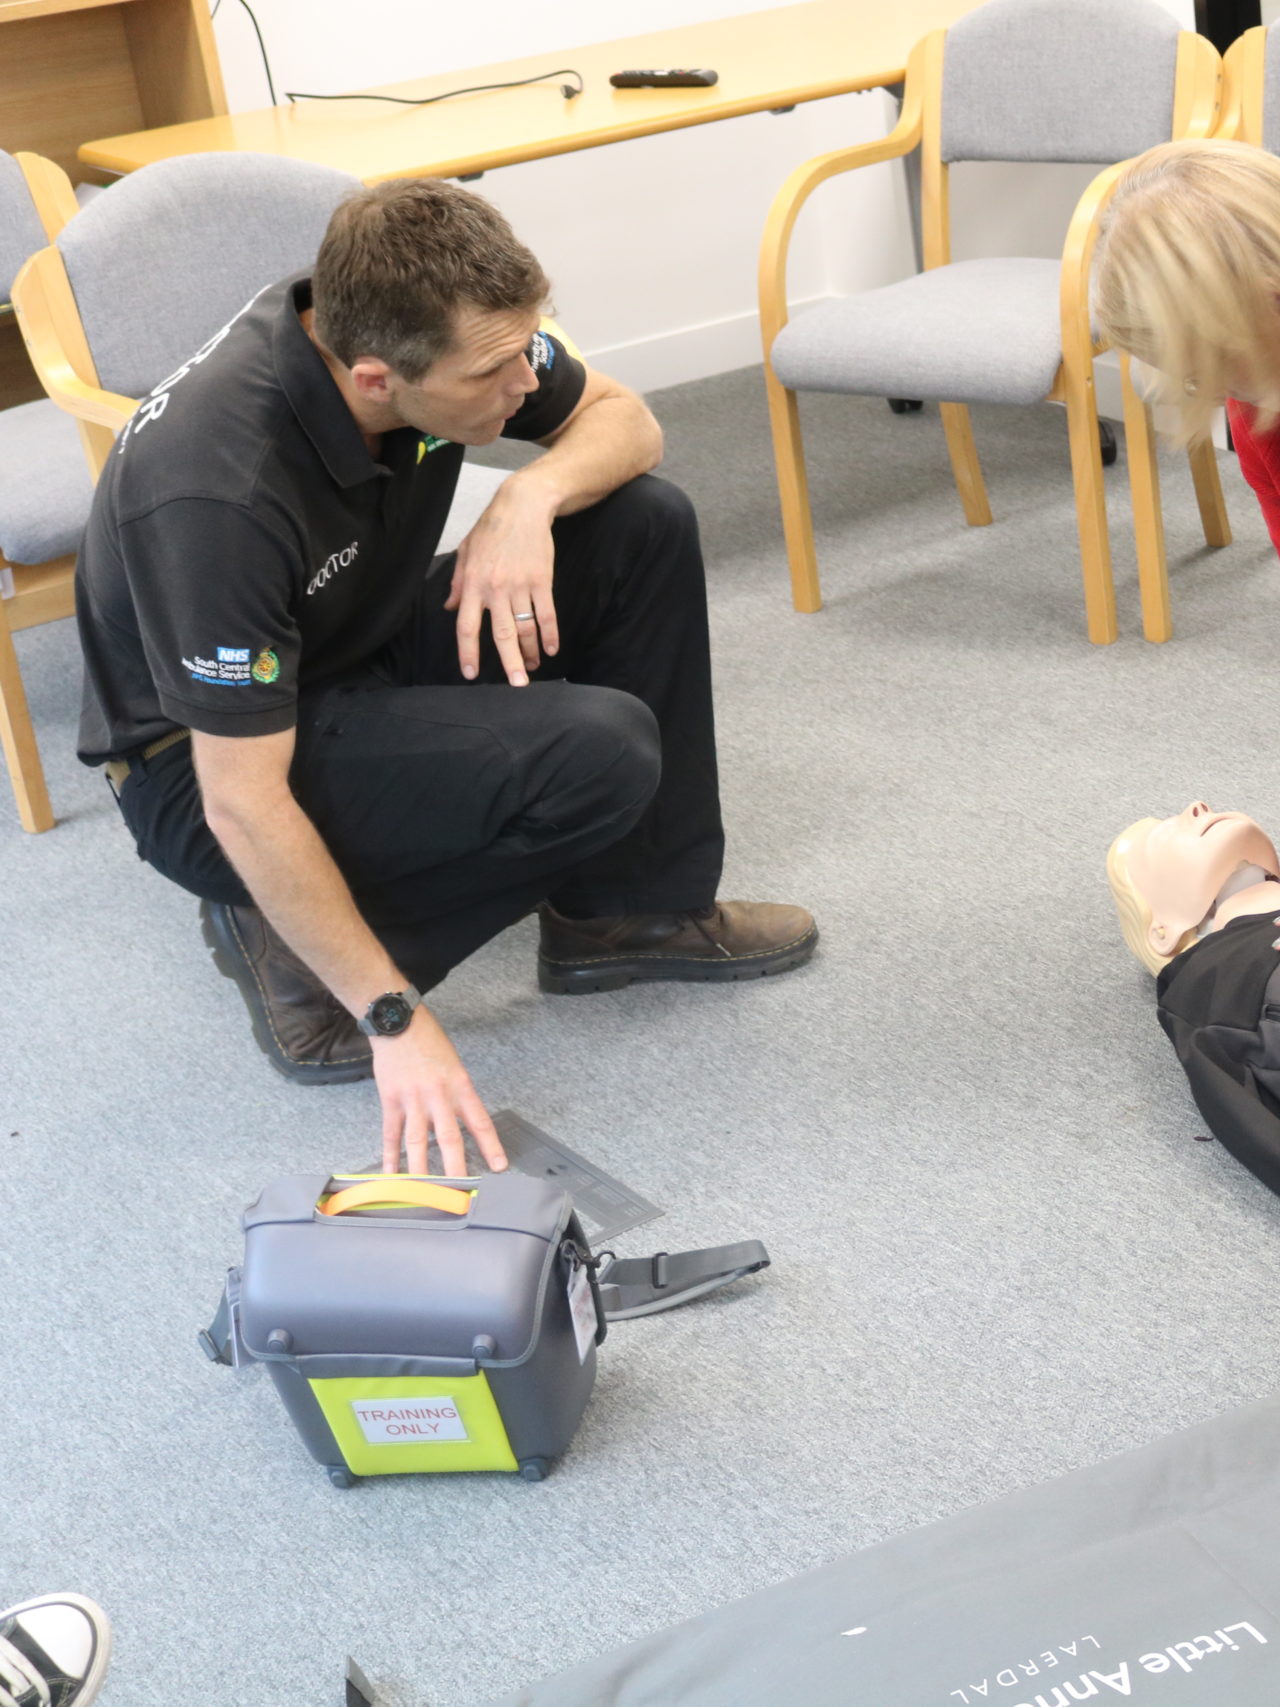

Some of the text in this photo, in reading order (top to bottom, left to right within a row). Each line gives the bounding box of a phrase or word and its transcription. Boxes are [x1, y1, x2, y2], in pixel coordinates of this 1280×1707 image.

[306, 541, 359, 595] DOCTOR
[219, 649, 249, 661] NHS
[194, 655, 251, 671] South Central
[218, 670, 251, 680] Service
[357, 1407, 457, 1421] TRAINING
[385, 1423, 440, 1436] ONLY
[950, 1634, 1101, 1705] LAERDAL
[1012, 1621, 1268, 1707] Little Ann
